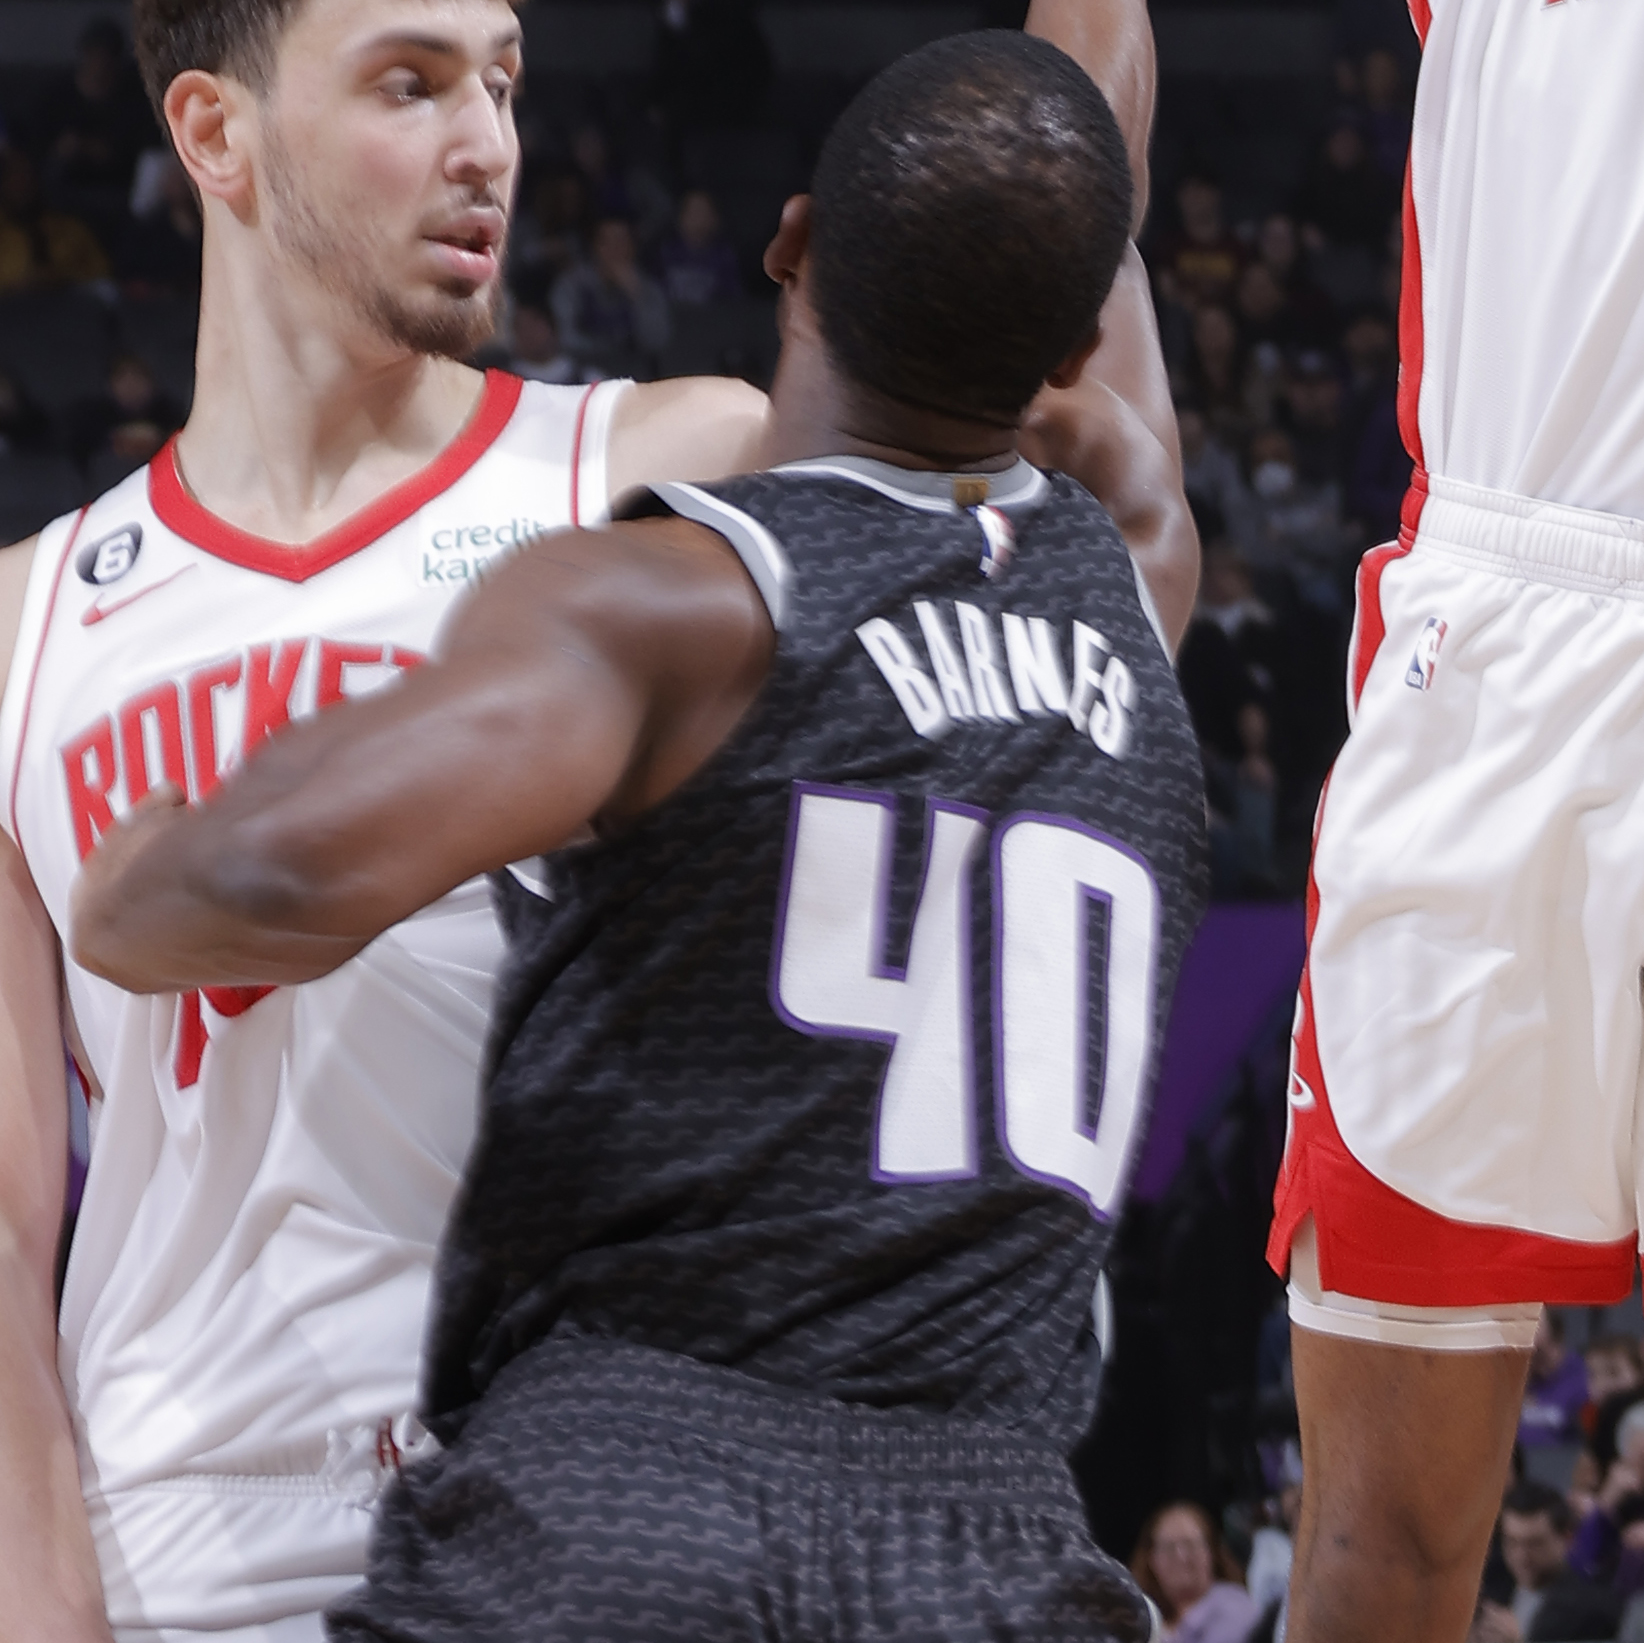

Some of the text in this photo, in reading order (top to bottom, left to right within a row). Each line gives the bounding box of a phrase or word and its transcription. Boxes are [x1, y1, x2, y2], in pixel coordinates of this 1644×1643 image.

[422, 553, 490, 583] kar
[855, 598, 1138, 758] BARNES
[768, 779, 1163, 1222] 40
